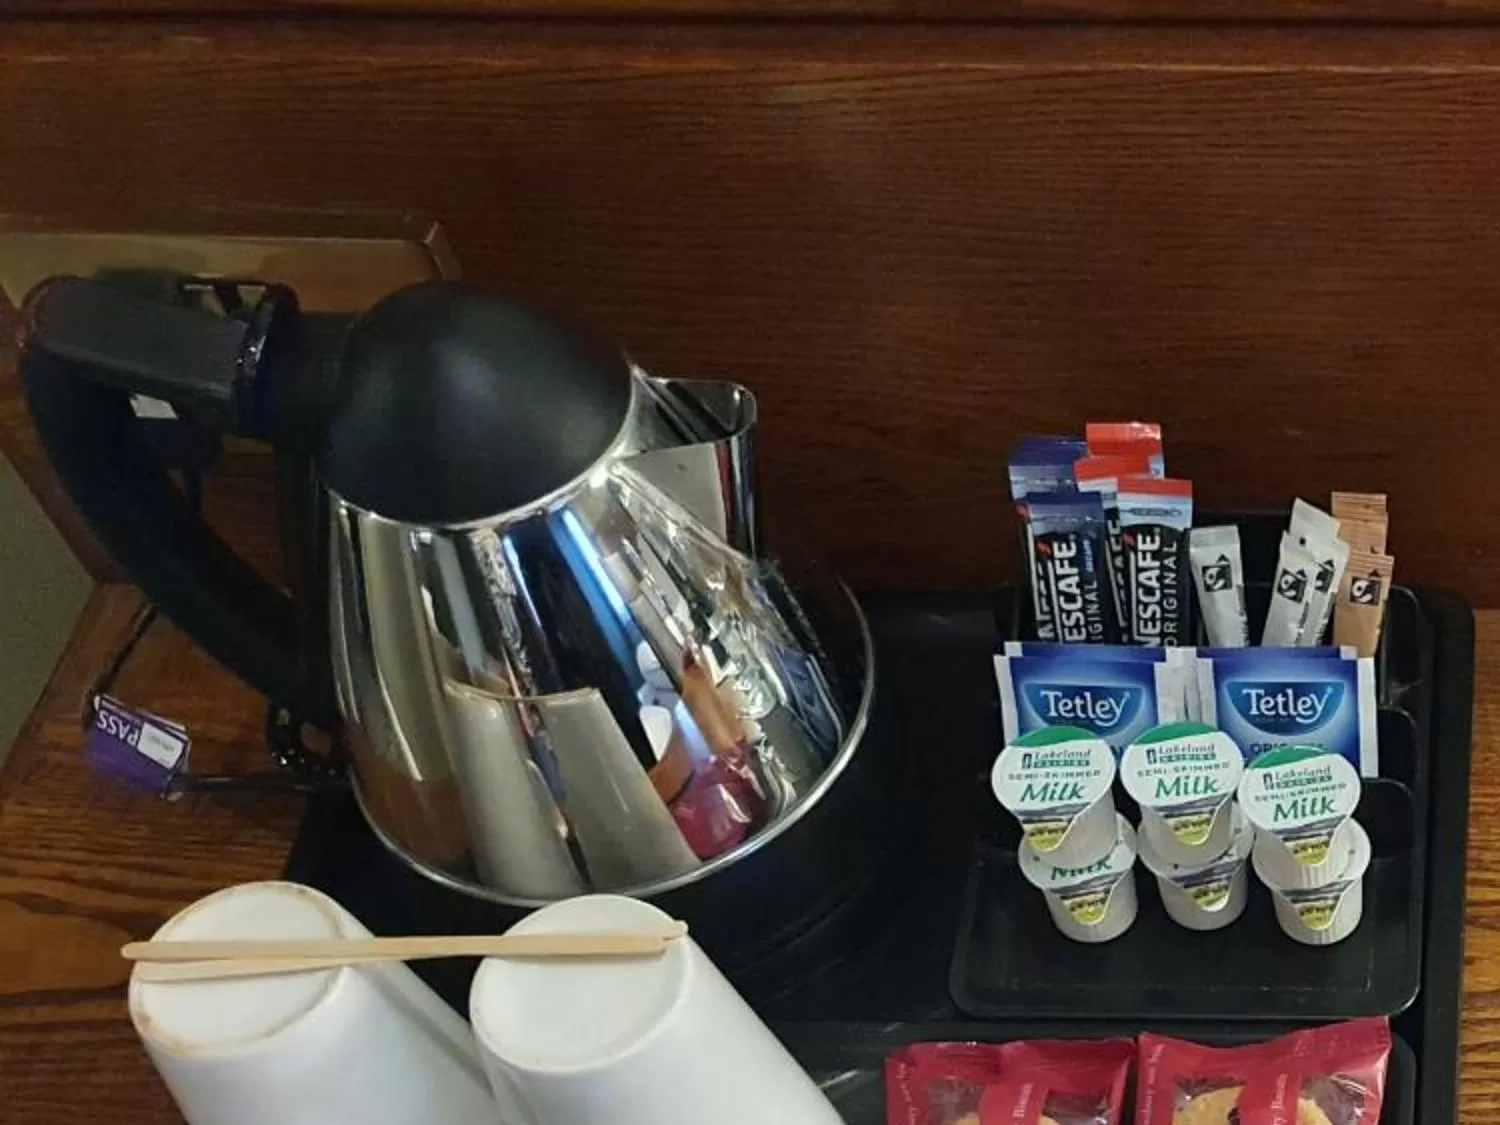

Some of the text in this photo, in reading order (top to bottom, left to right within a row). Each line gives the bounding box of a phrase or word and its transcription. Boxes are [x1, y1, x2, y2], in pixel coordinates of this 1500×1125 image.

[1082, 579, 1104, 641] IGINAL
[1162, 540, 1178, 648] ORIGINAL
[1039, 689, 1132, 728] Tetley
[1240, 685, 1334, 725] Tetley
[96, 709, 140, 748] PASS
[1019, 781, 1088, 804] Milk
[1154, 775, 1222, 800] Milk
[1272, 796, 1338, 824] Milk
